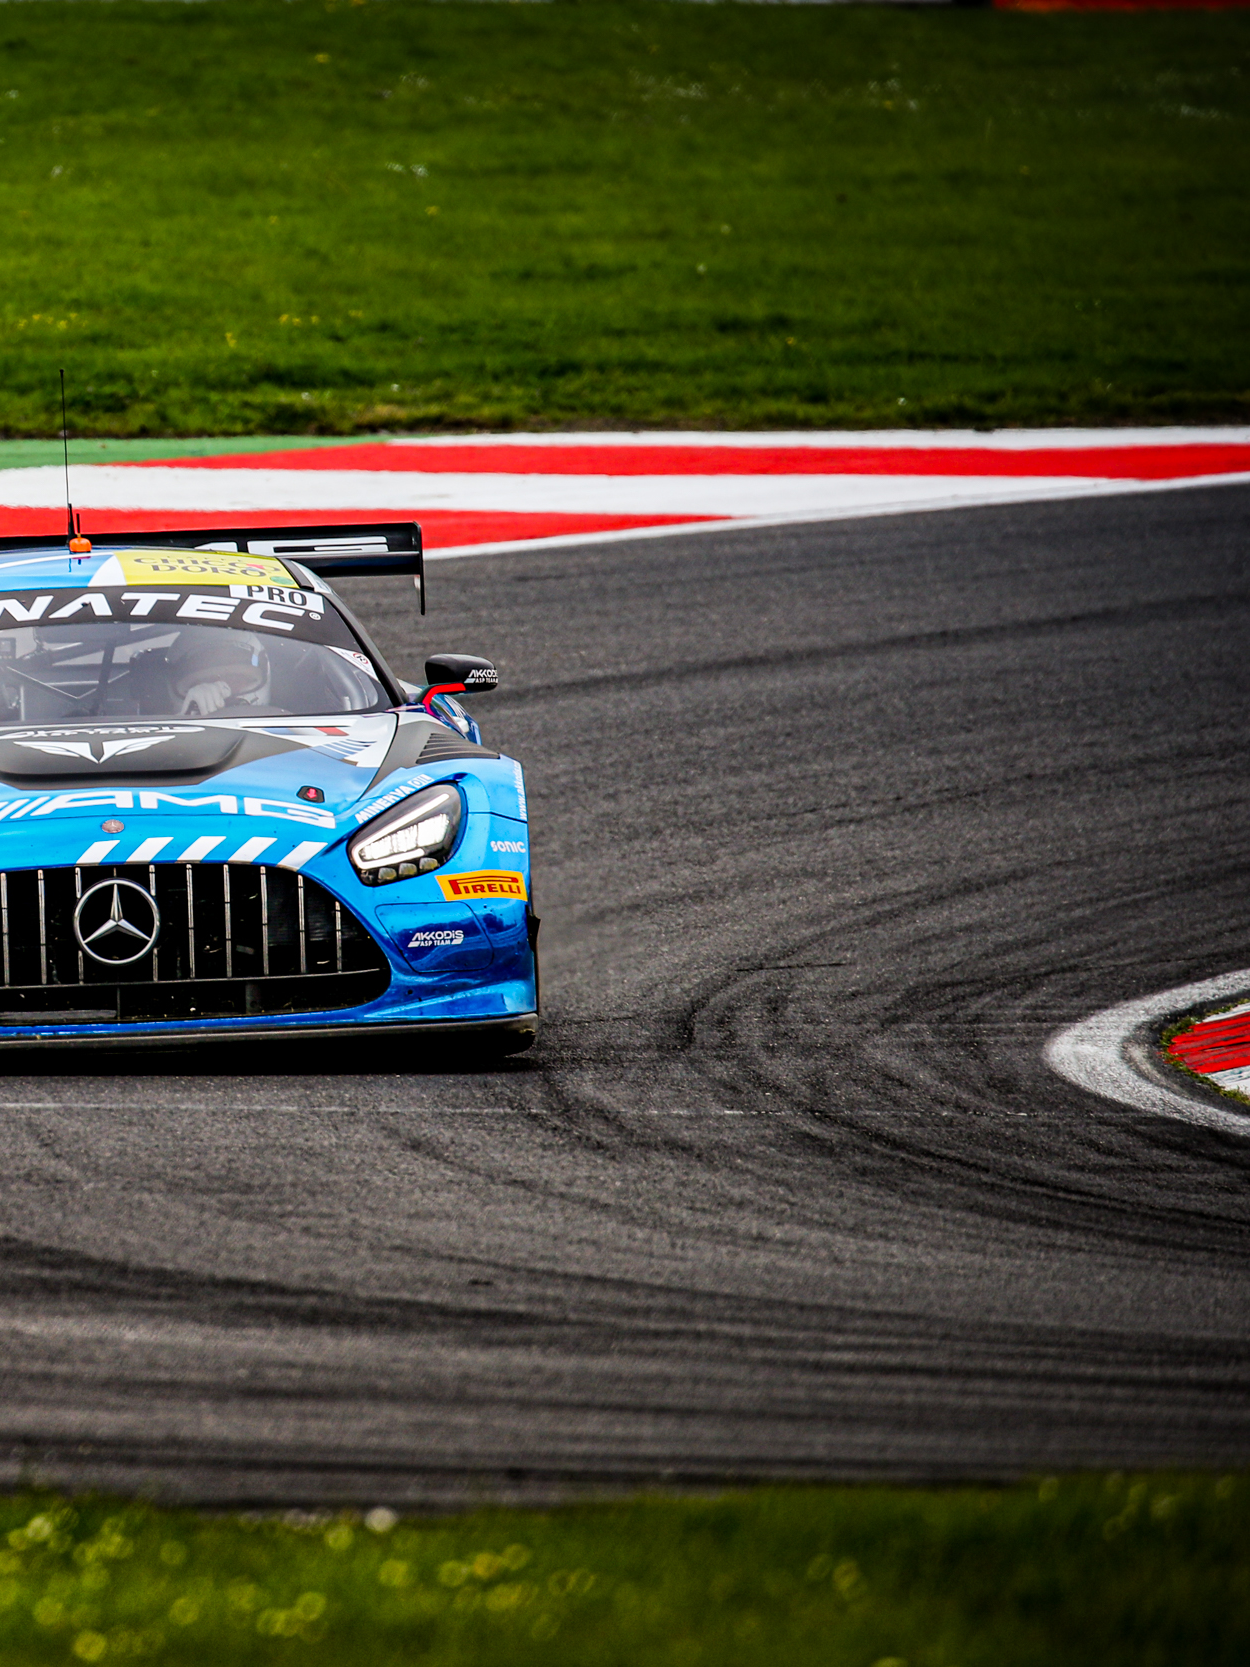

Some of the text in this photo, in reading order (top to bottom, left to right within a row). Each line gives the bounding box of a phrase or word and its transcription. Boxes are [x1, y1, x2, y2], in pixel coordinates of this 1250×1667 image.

[246, 585, 308, 606] PRO
[355, 786, 416, 824] MINERVA
[448, 875, 522, 895] PIRELLI
